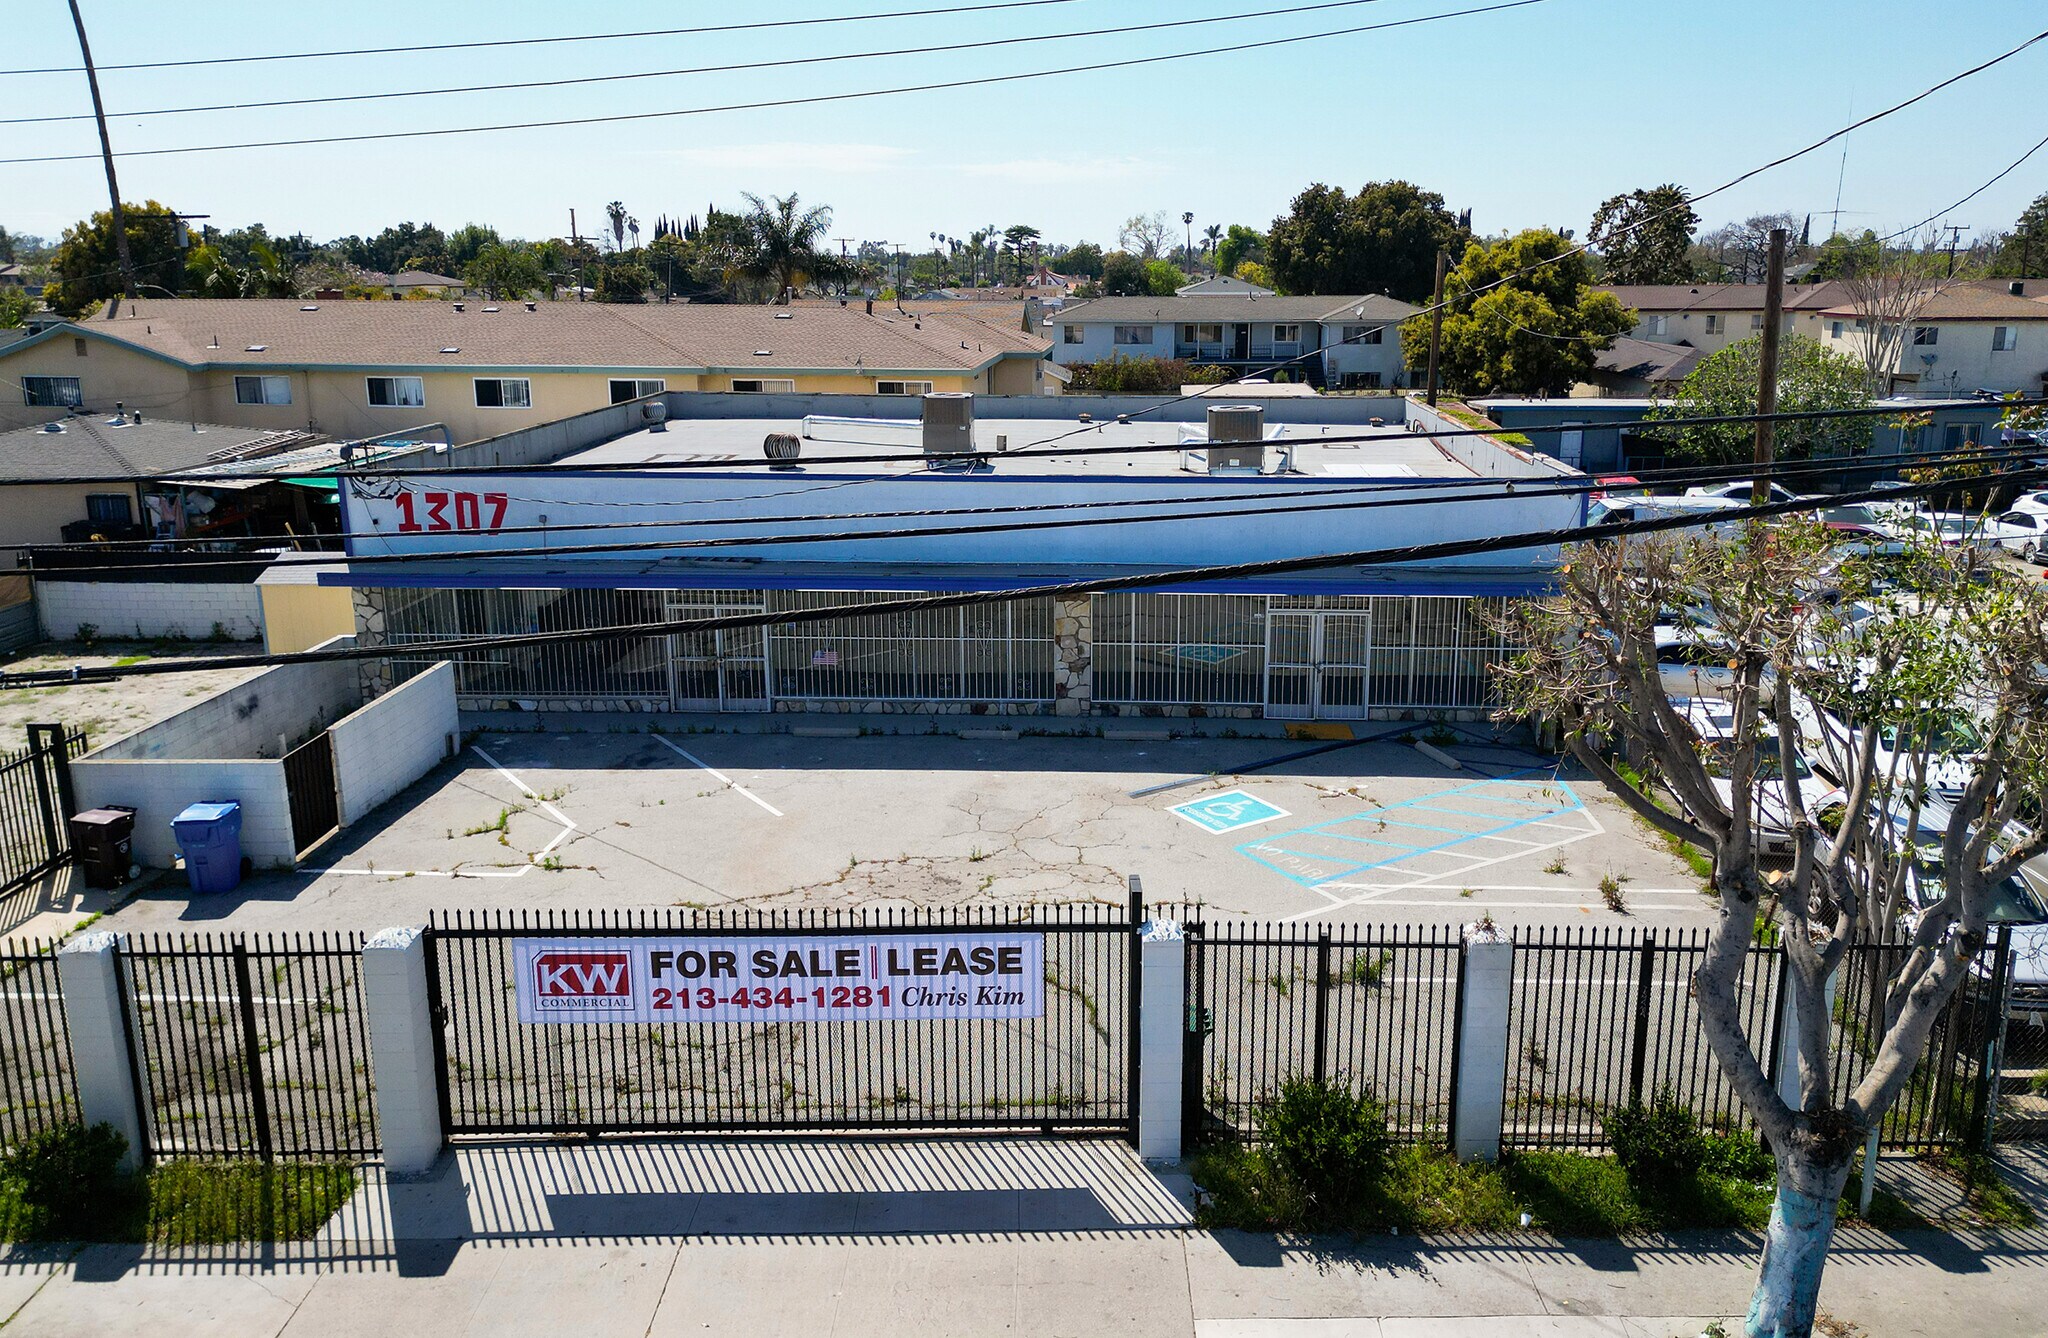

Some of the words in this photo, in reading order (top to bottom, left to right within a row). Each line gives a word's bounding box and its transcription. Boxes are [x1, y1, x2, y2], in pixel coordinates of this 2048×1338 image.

[395, 492, 508, 536] 1307
[650, 950, 738, 979] FOR
[751, 949, 862, 979] SALE
[887, 946, 1023, 976] LEASE
[538, 963, 627, 994] KW
[541, 998, 630, 1008] COMMERCIAL
[652, 985, 891, 1010] 213-434-1281
[901, 985, 968, 1007] Chris
[974, 985, 1026, 1006] Kim
